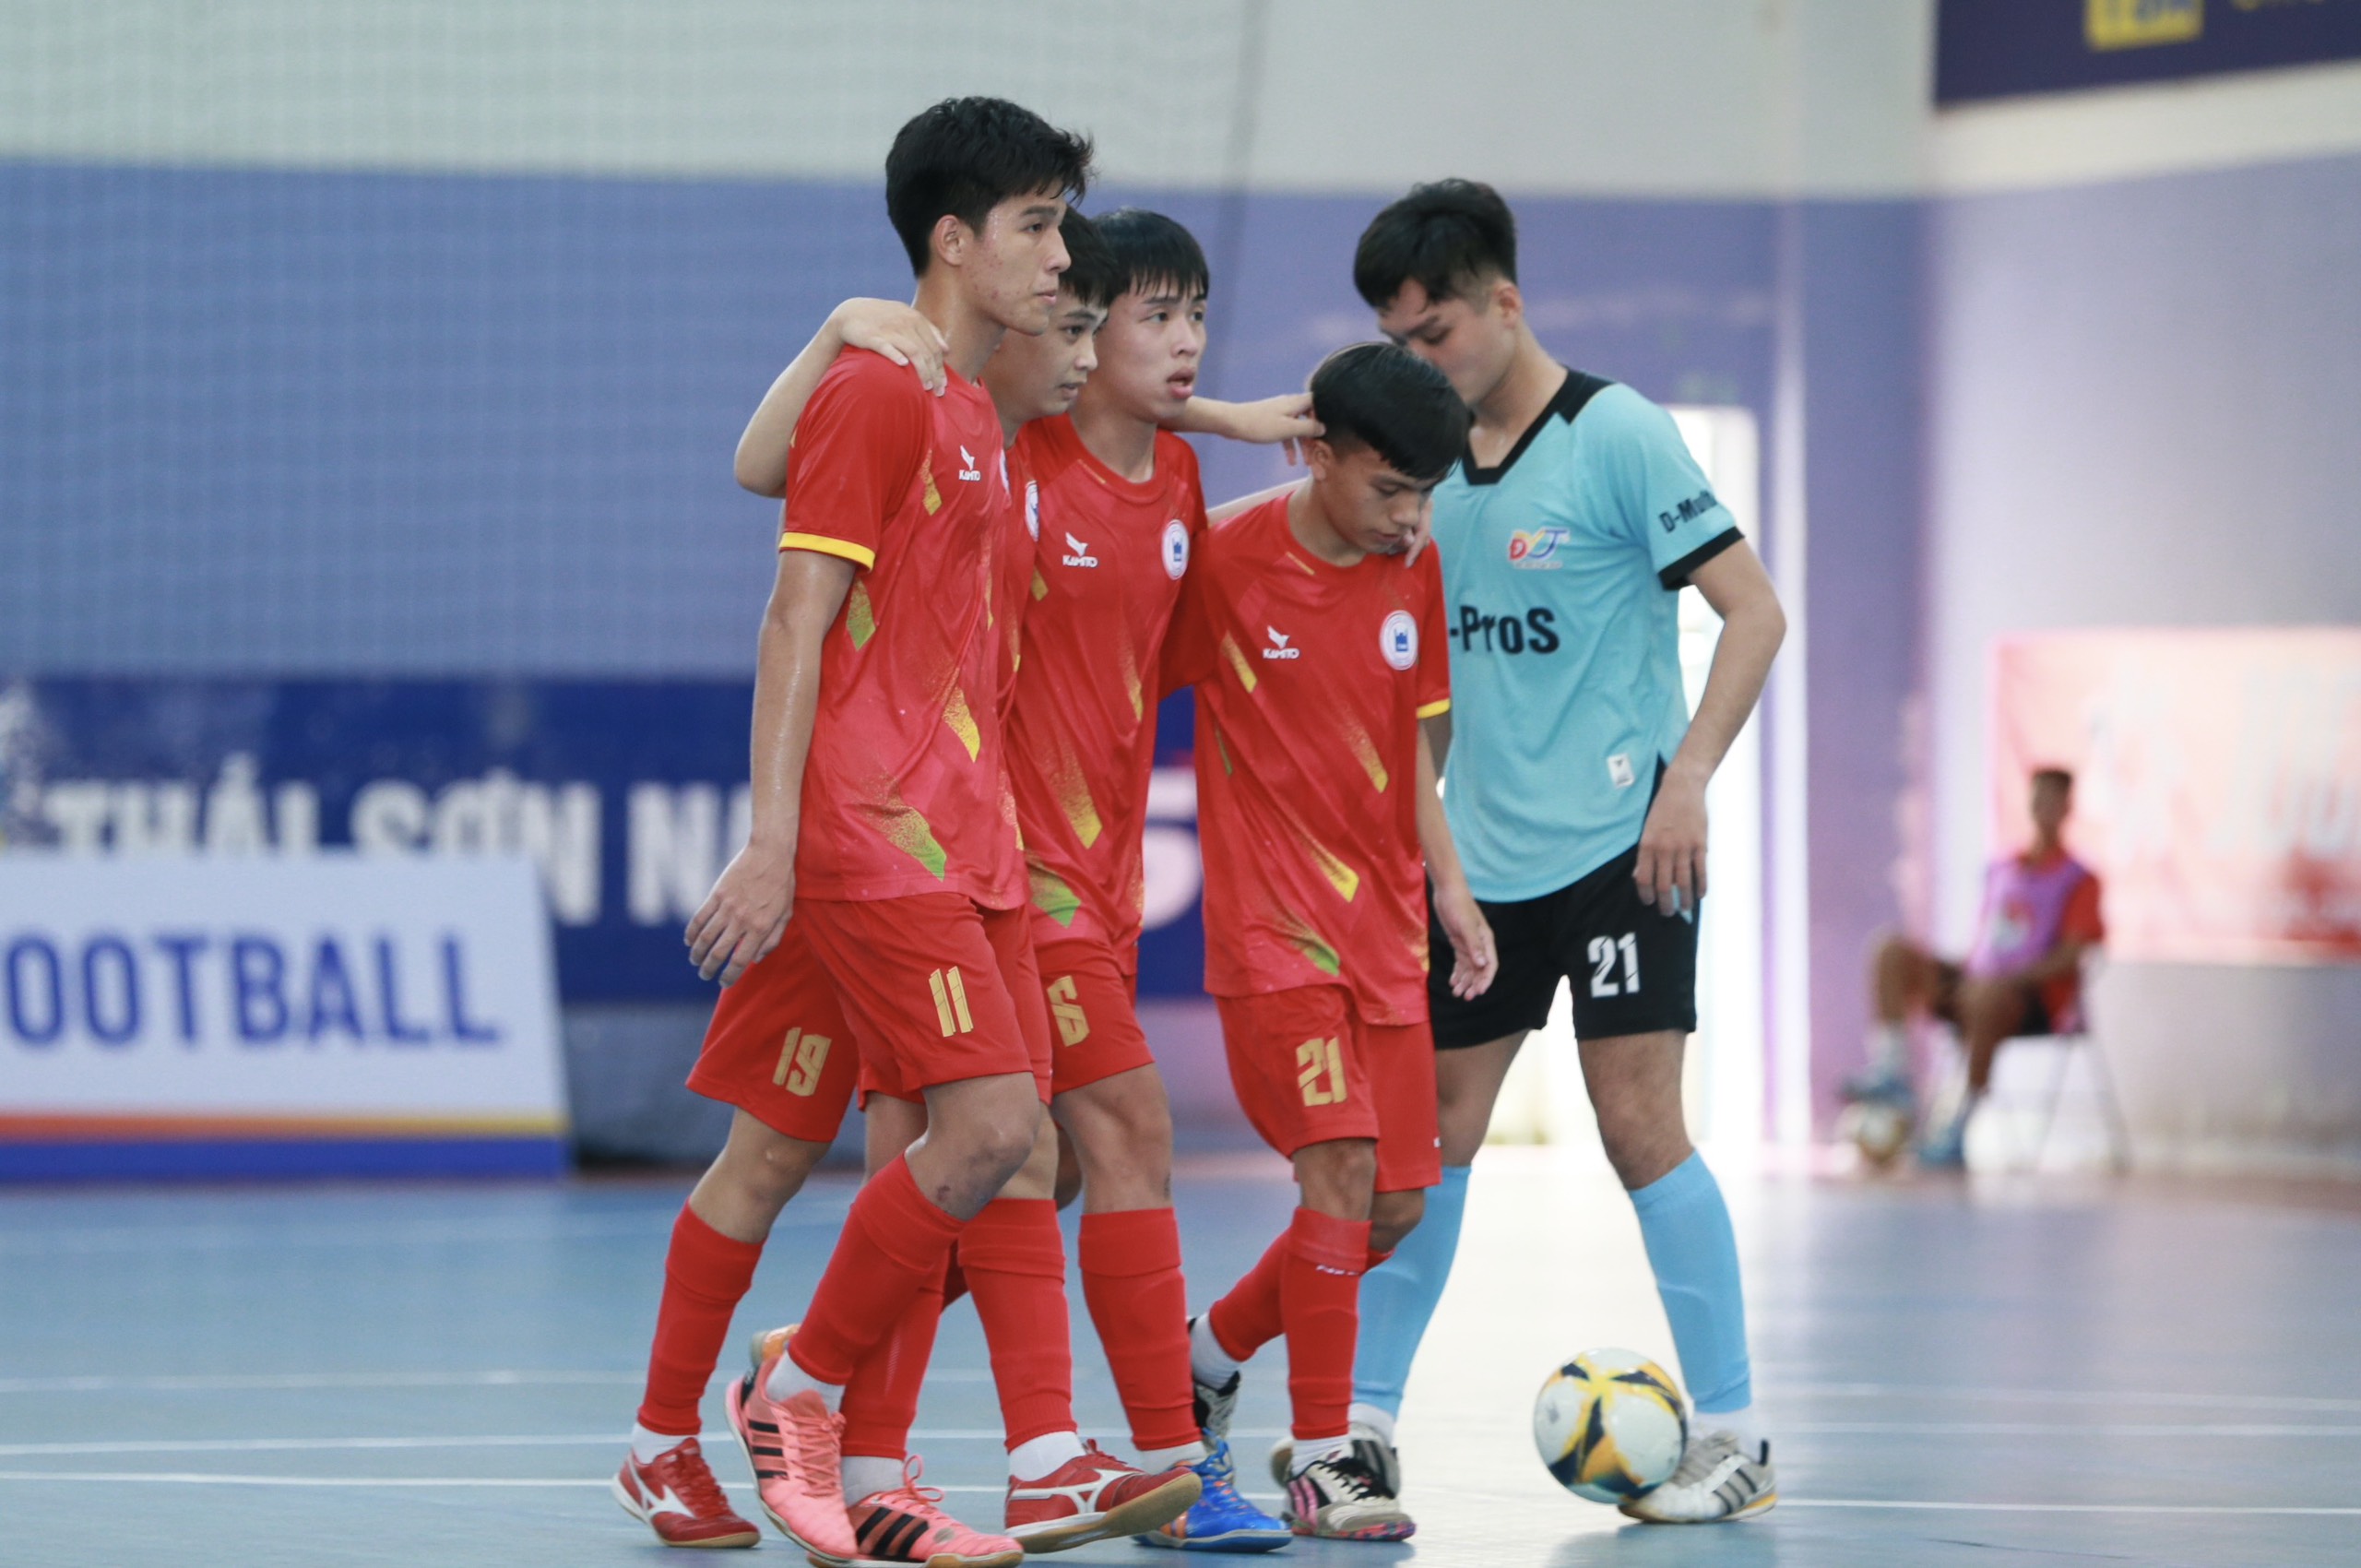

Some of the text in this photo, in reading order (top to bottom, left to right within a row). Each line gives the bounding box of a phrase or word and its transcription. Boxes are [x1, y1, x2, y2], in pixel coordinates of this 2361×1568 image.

[6, 934, 501, 1048] OOTBALL
[1587, 932, 1641, 999] 21
[928, 966, 974, 1038] 11
[1047, 975, 1090, 1047] 6
[772, 1027, 832, 1098] 19
[1296, 1036, 1349, 1107] 21
